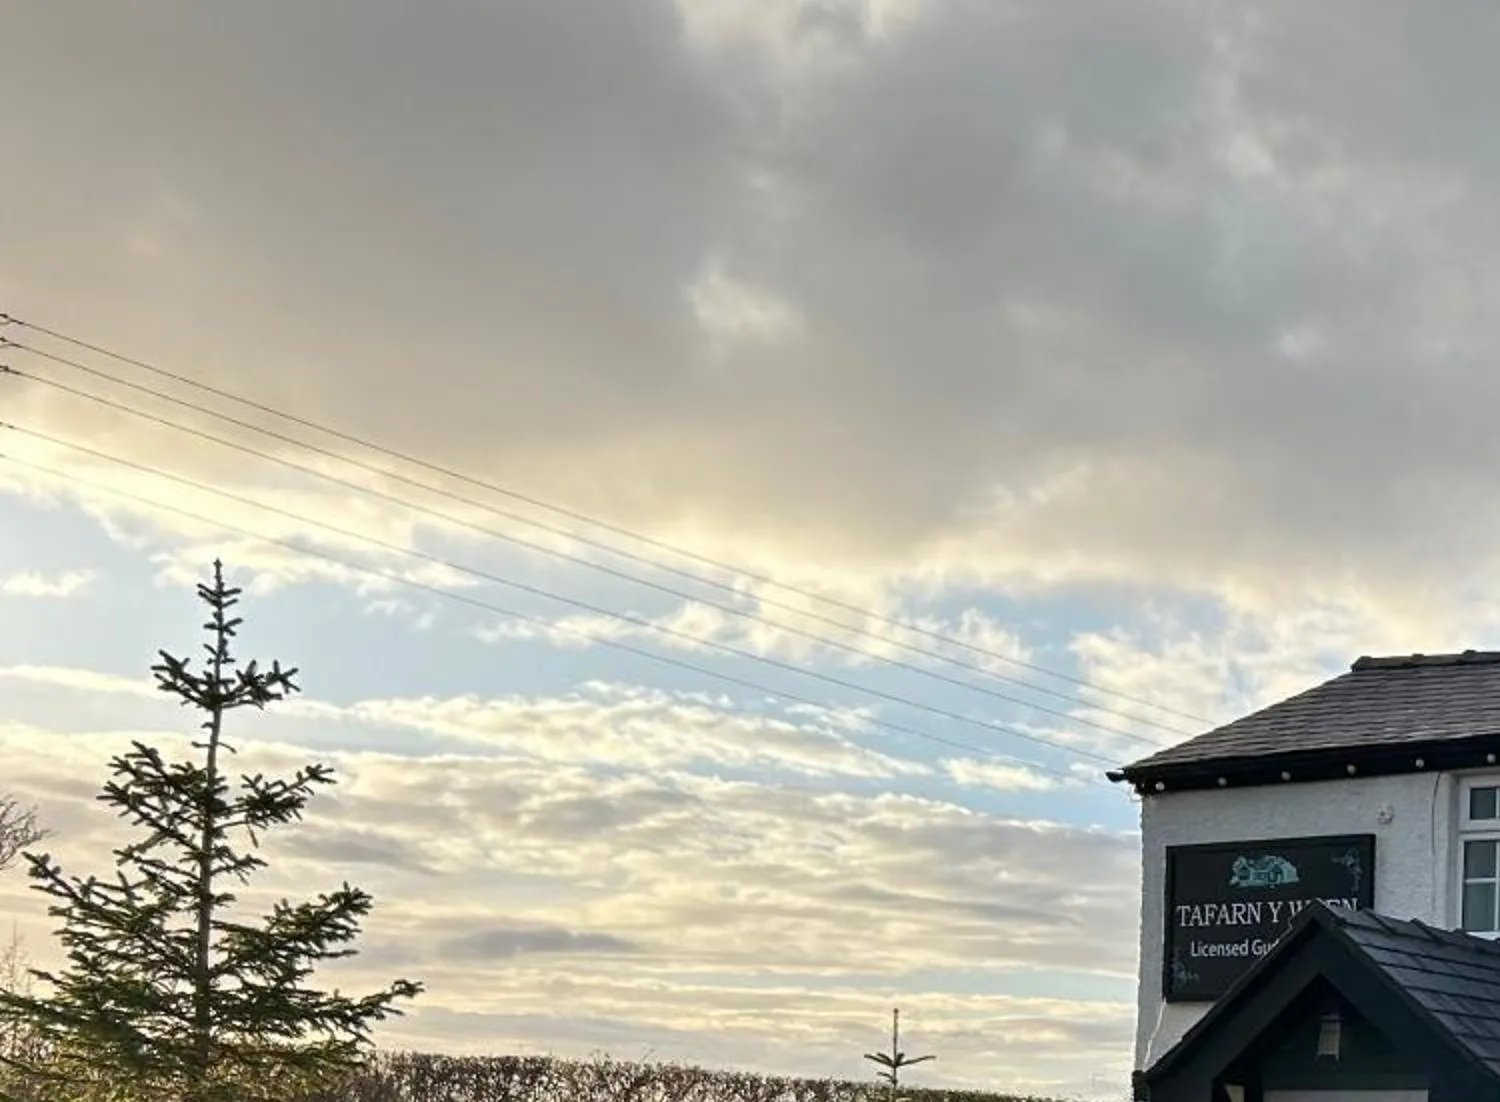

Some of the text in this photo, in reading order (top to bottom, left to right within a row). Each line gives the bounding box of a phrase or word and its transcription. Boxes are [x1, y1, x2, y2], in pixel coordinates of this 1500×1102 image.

[1177, 902, 1262, 927] TAFARN
[1267, 901, 1283, 924] Y
[1191, 938, 1249, 957] Licensed
